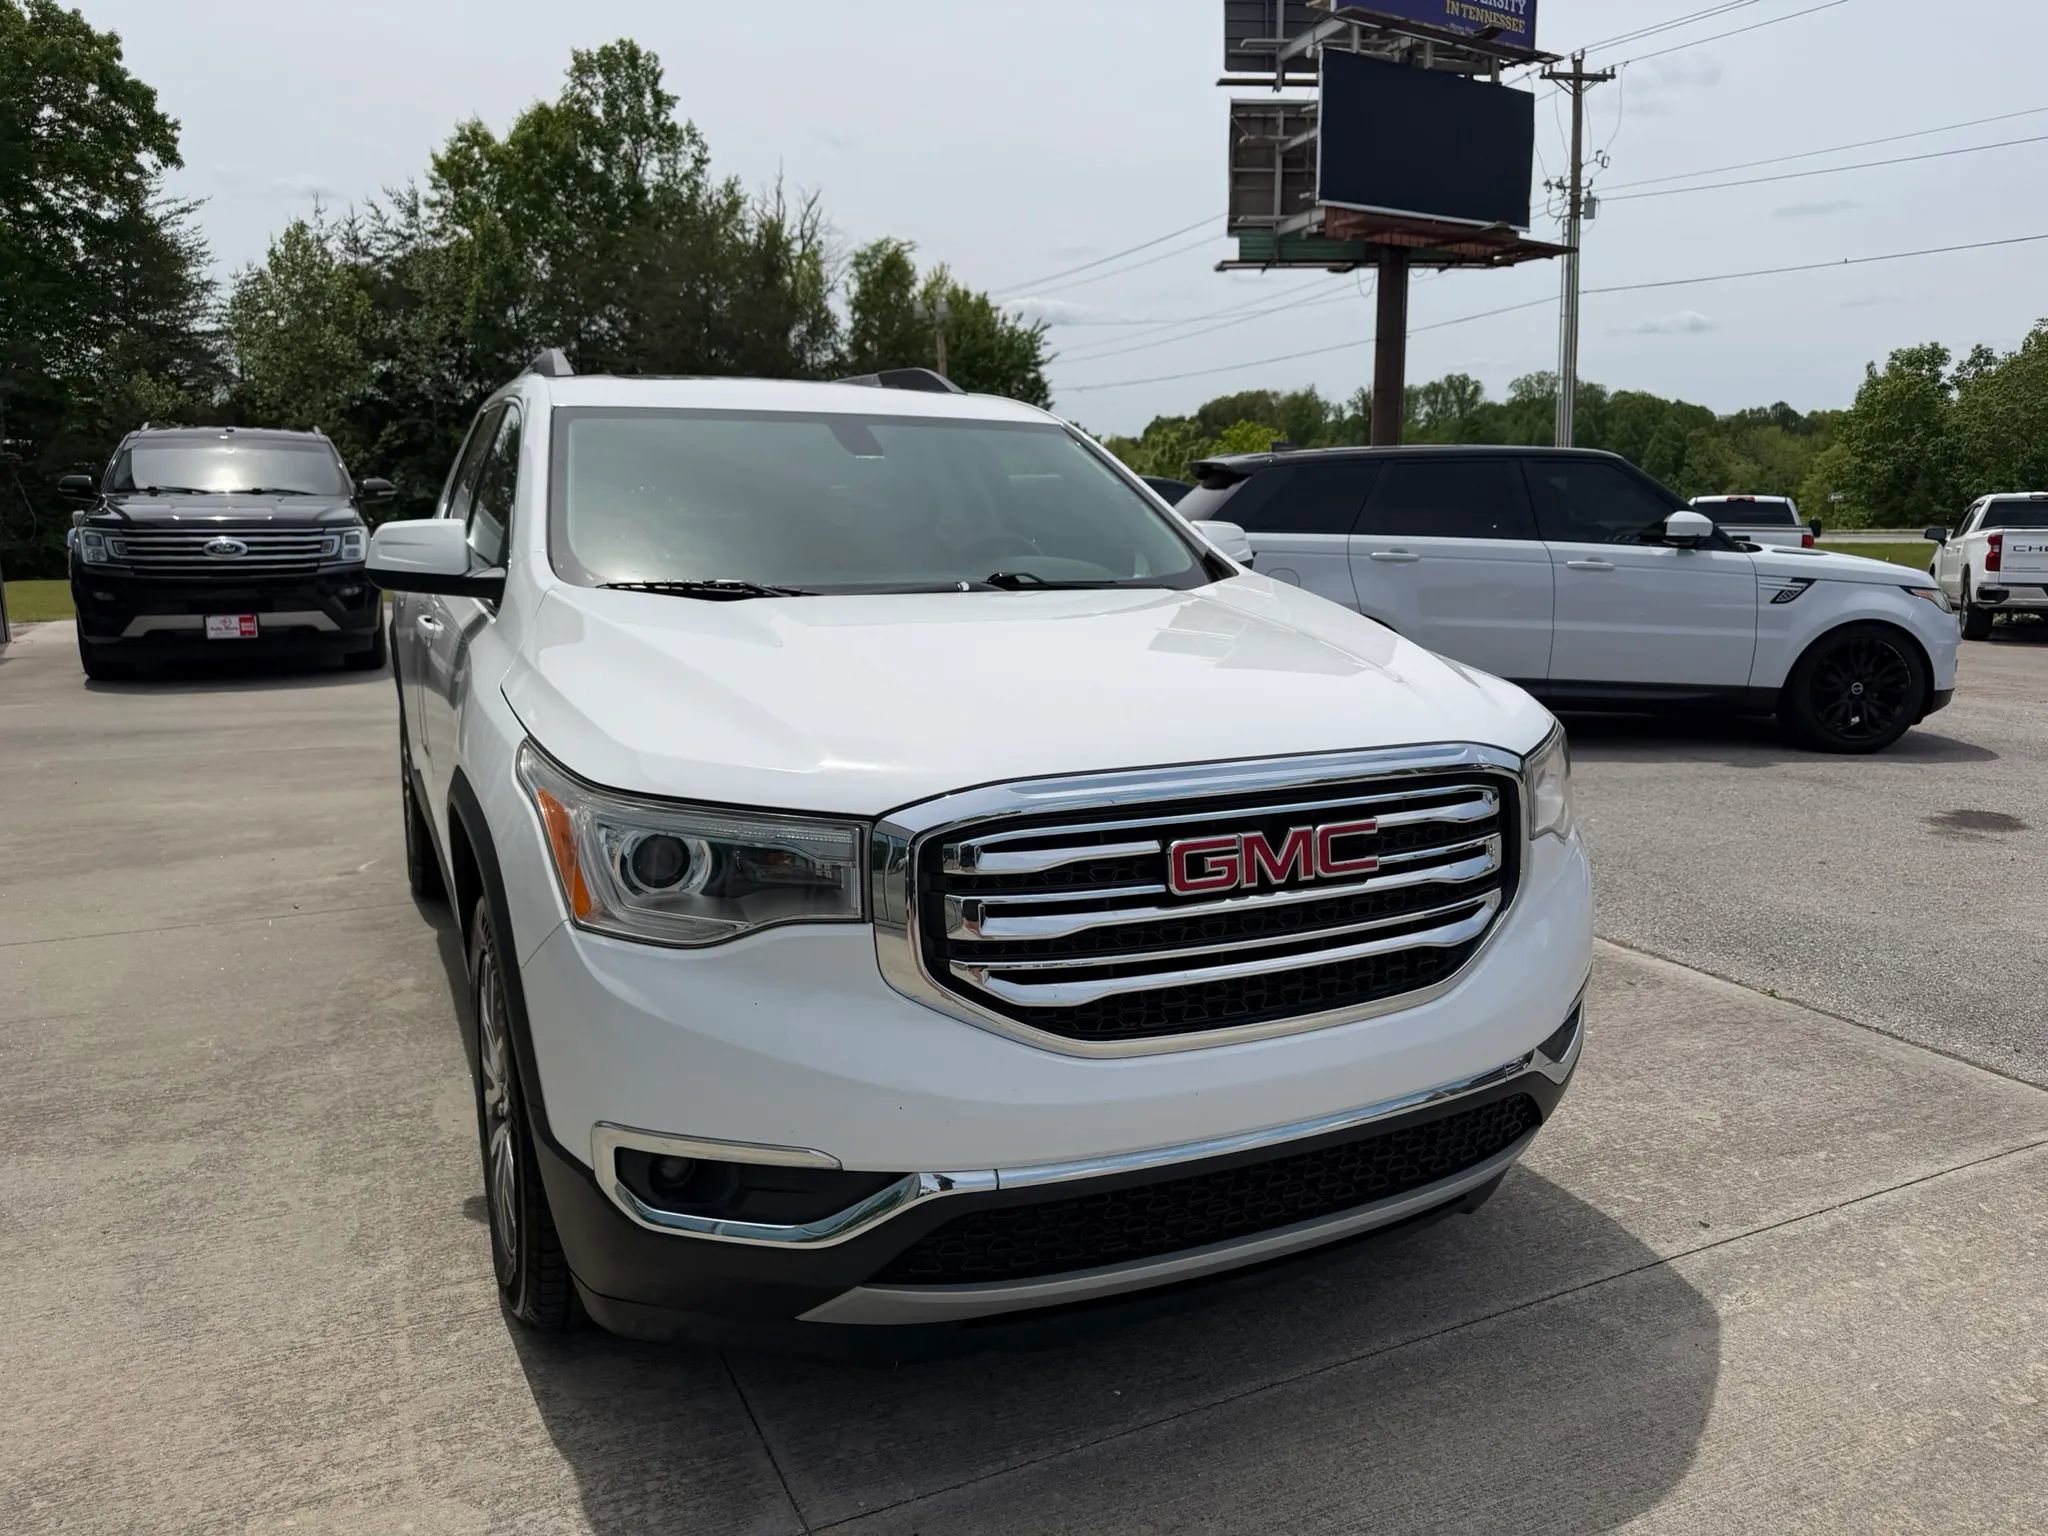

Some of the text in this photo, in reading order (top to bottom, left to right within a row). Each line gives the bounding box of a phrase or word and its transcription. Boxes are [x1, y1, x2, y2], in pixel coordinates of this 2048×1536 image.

[1445, 0, 1460, 17] IN
[1460, 5, 1526, 34] TENNESSEE
[1474, 0, 1527, 15] RSITY
[1168, 817, 1379, 896] GMC
